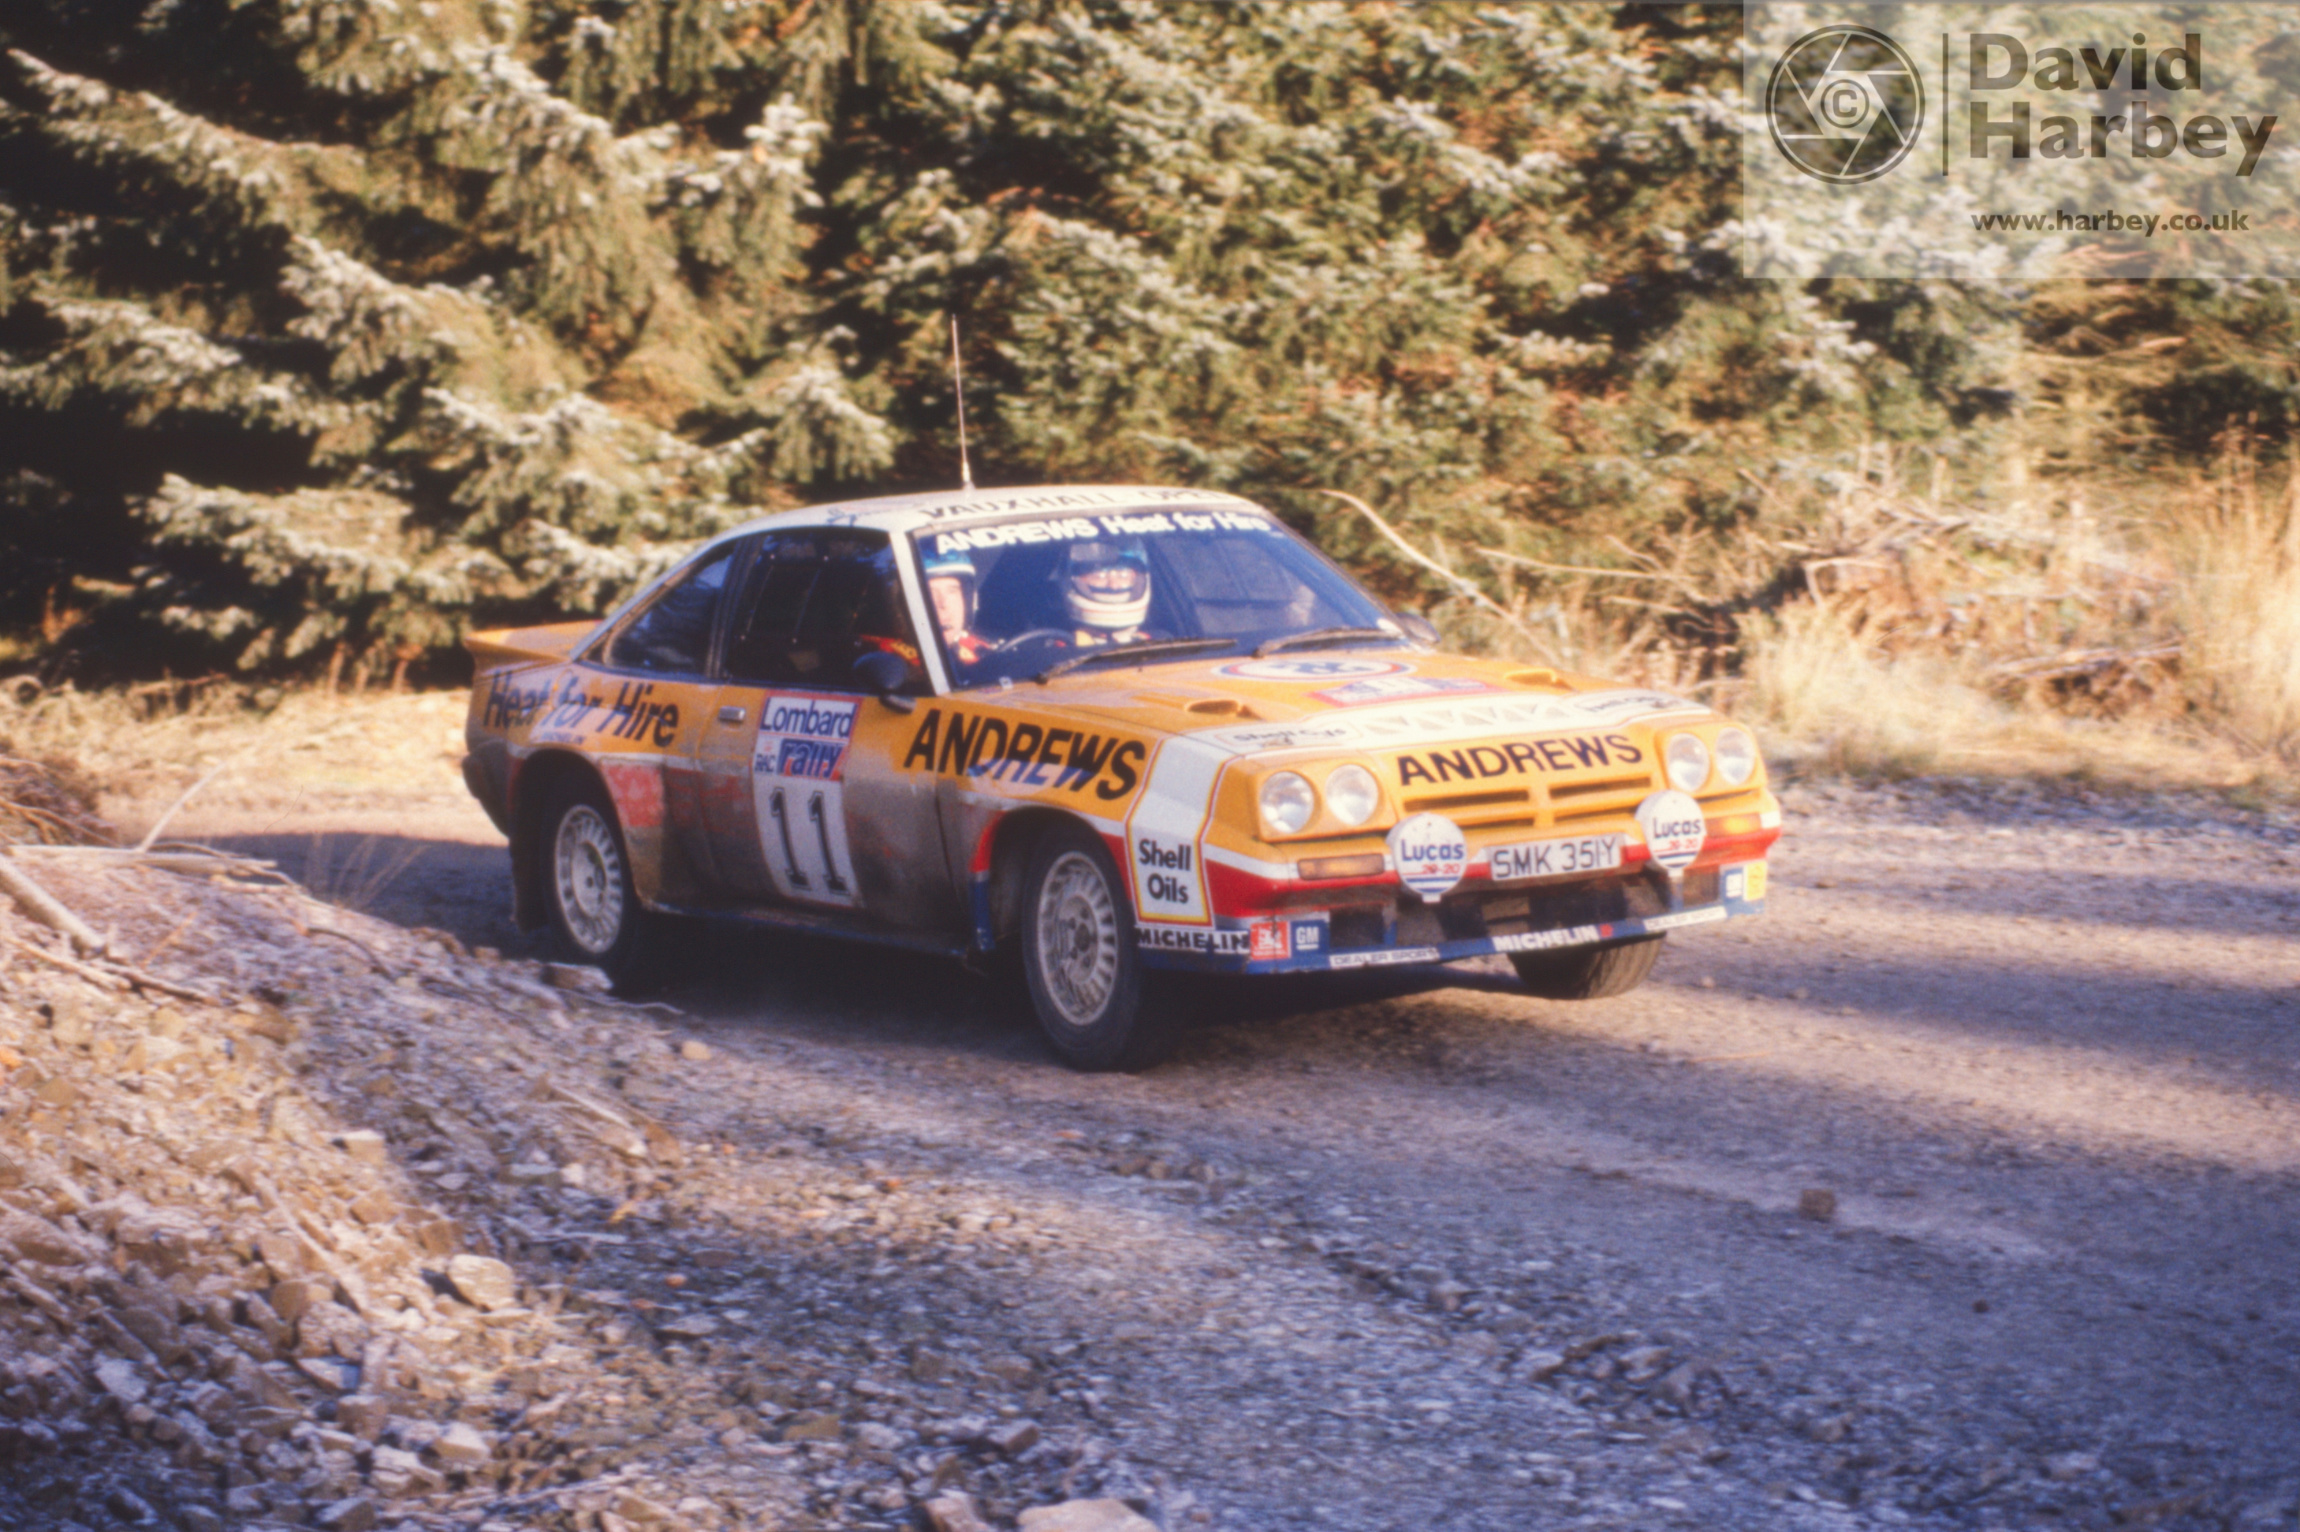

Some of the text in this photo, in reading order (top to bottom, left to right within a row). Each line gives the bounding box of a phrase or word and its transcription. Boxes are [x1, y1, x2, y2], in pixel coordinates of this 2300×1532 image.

[936, 511, 1272, 555] ANDREWS Heat for Hire
[483, 670, 680, 748] Heat for Hire
[760, 696, 858, 738] Lombard
[778, 740, 843, 778] rally
[904, 708, 1147, 801] ANDREWS
[1397, 734, 1643, 787] ANDREWS
[768, 785, 852, 897] 11
[1653, 817, 1701, 839] Lucas
[1139, 837, 1192, 872] Shell
[1401, 839, 1464, 861] Lucas
[1493, 839, 1617, 880] SMK 351Y
[1147, 873, 1189, 905] Oils
[1136, 928, 1250, 951] MICHELIN
[1296, 926, 1320, 944] GM
[1492, 925, 1600, 952] MICHELIN
